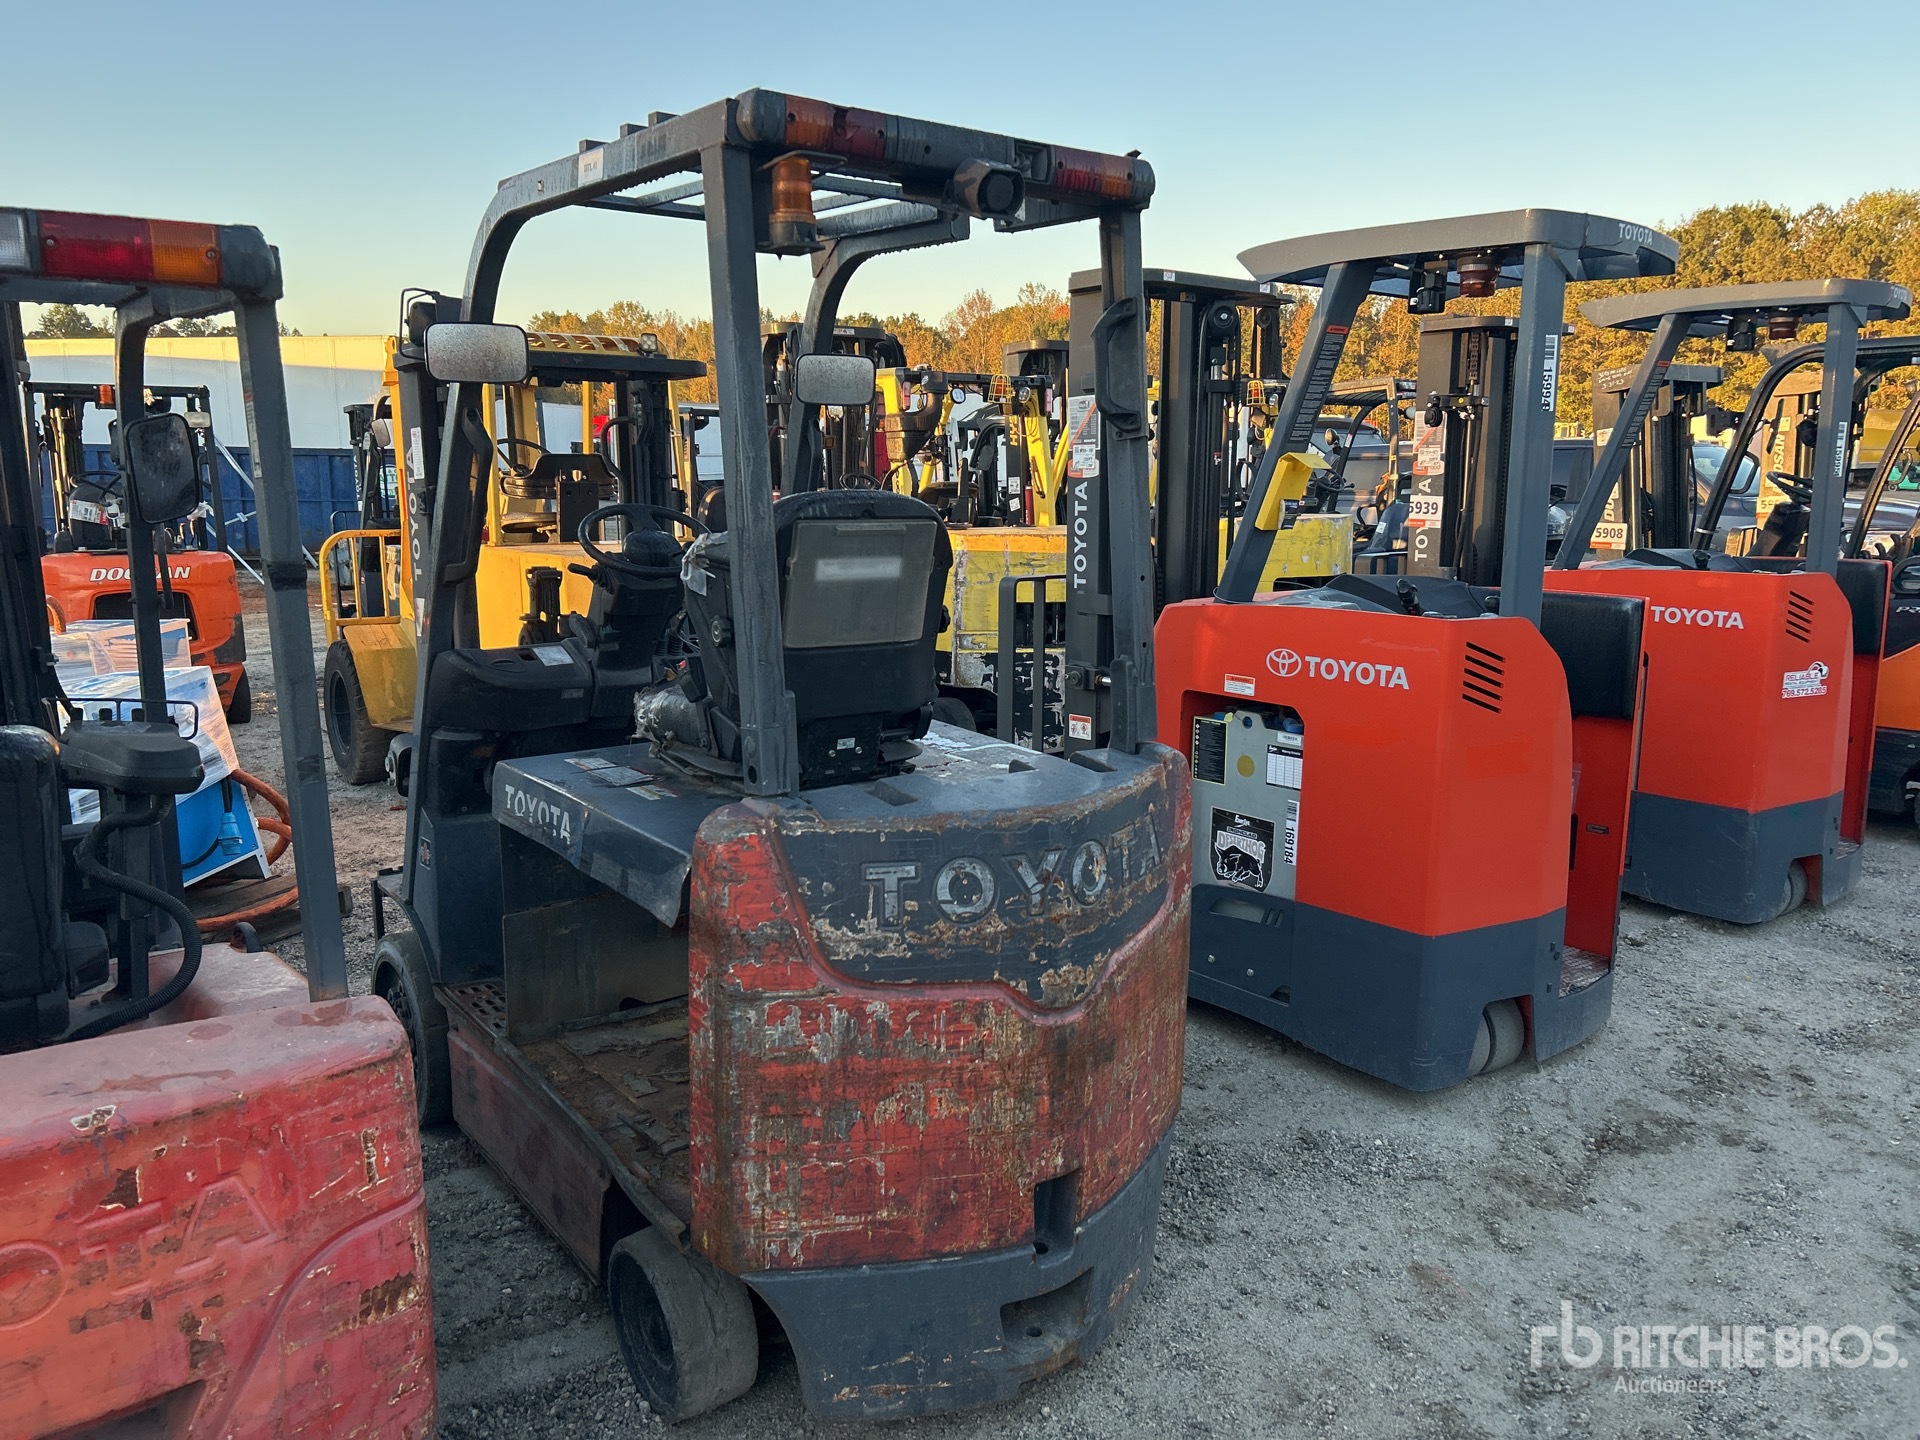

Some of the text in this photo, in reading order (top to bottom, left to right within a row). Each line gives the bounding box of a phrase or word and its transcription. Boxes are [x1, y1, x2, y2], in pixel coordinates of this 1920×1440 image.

[1618, 223, 1653, 246] TOYOTA
[353, 455, 361, 500] TOYOTA
[406, 446, 423, 582] TOYOTA
[1074, 481, 1088, 589] TOYOTA
[1415, 478, 1432, 562] TOYA
[1595, 527, 1624, 539] 5908
[1651, 606, 1744, 630] TOYOTA
[1305, 655, 1410, 690] TOYOTA
[505, 783, 571, 845] TOYOTA
[1284, 826, 1296, 865] 169184
[861, 812, 1162, 927] TOYOTA
